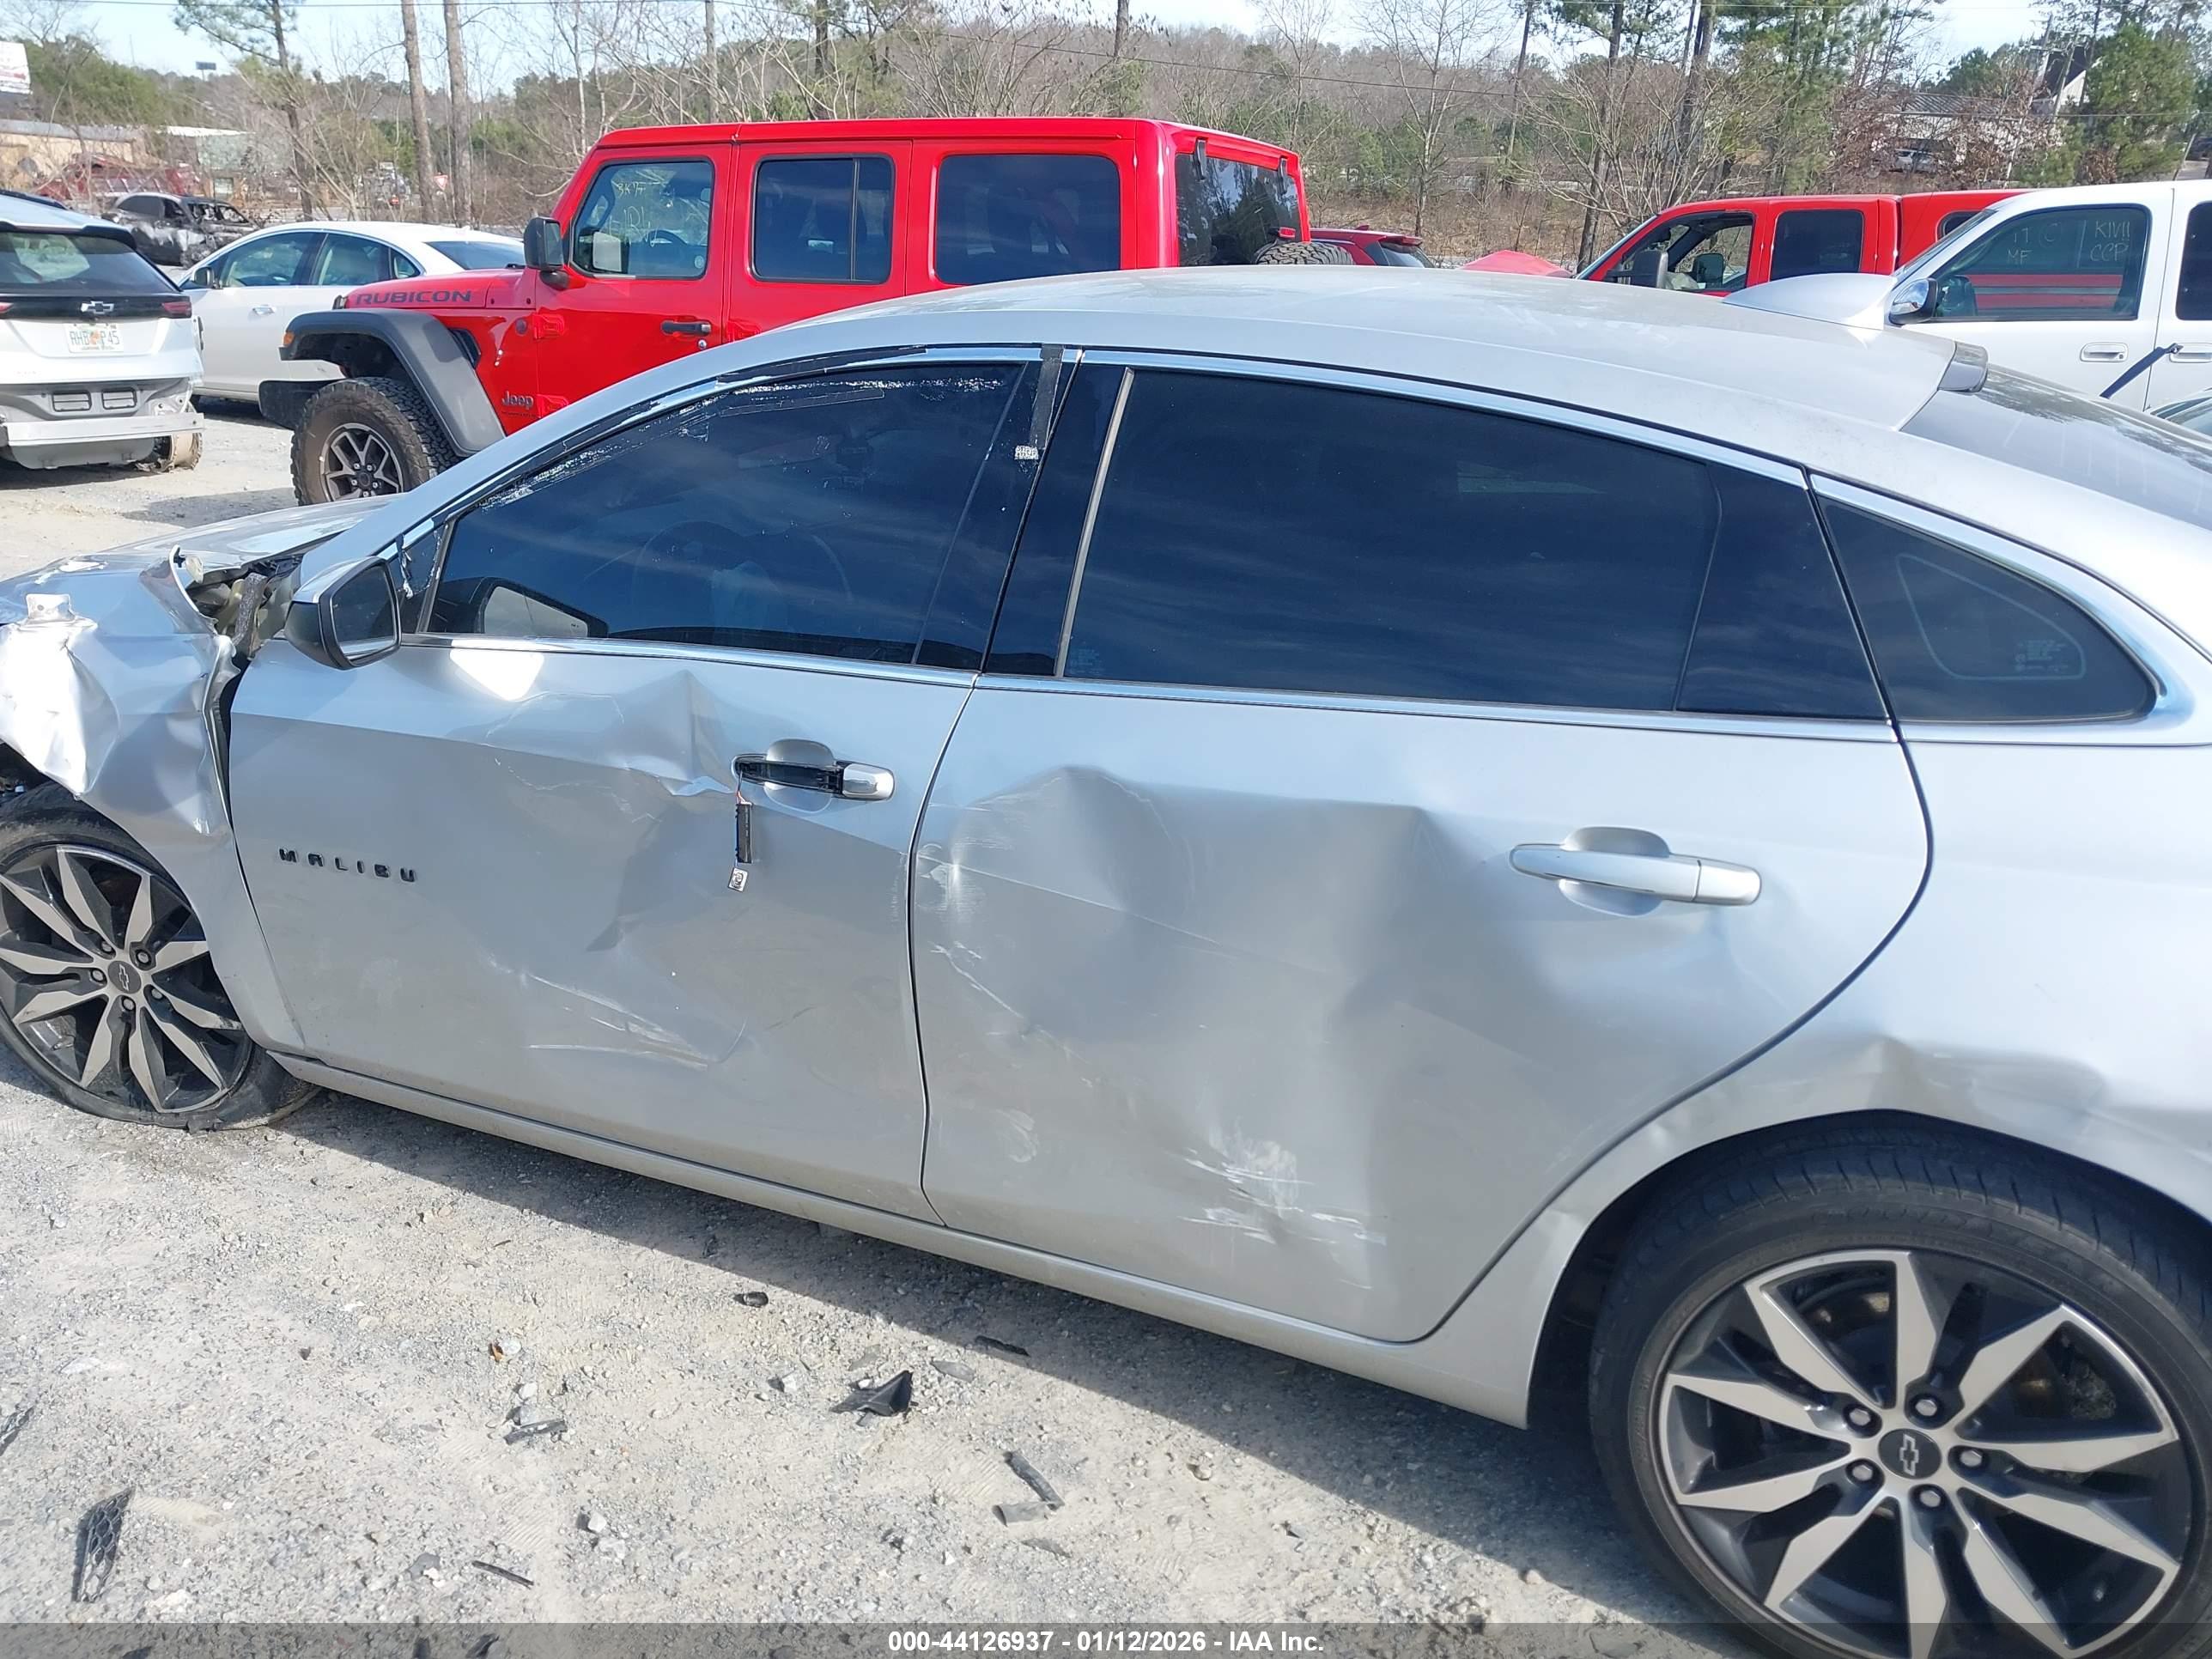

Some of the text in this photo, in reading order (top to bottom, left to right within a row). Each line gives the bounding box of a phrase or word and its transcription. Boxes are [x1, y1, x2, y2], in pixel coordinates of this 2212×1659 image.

[355, 289, 471, 305] RUBICON
[501, 391, 534, 410] Jeep
[278, 848, 416, 883] MALIBU
